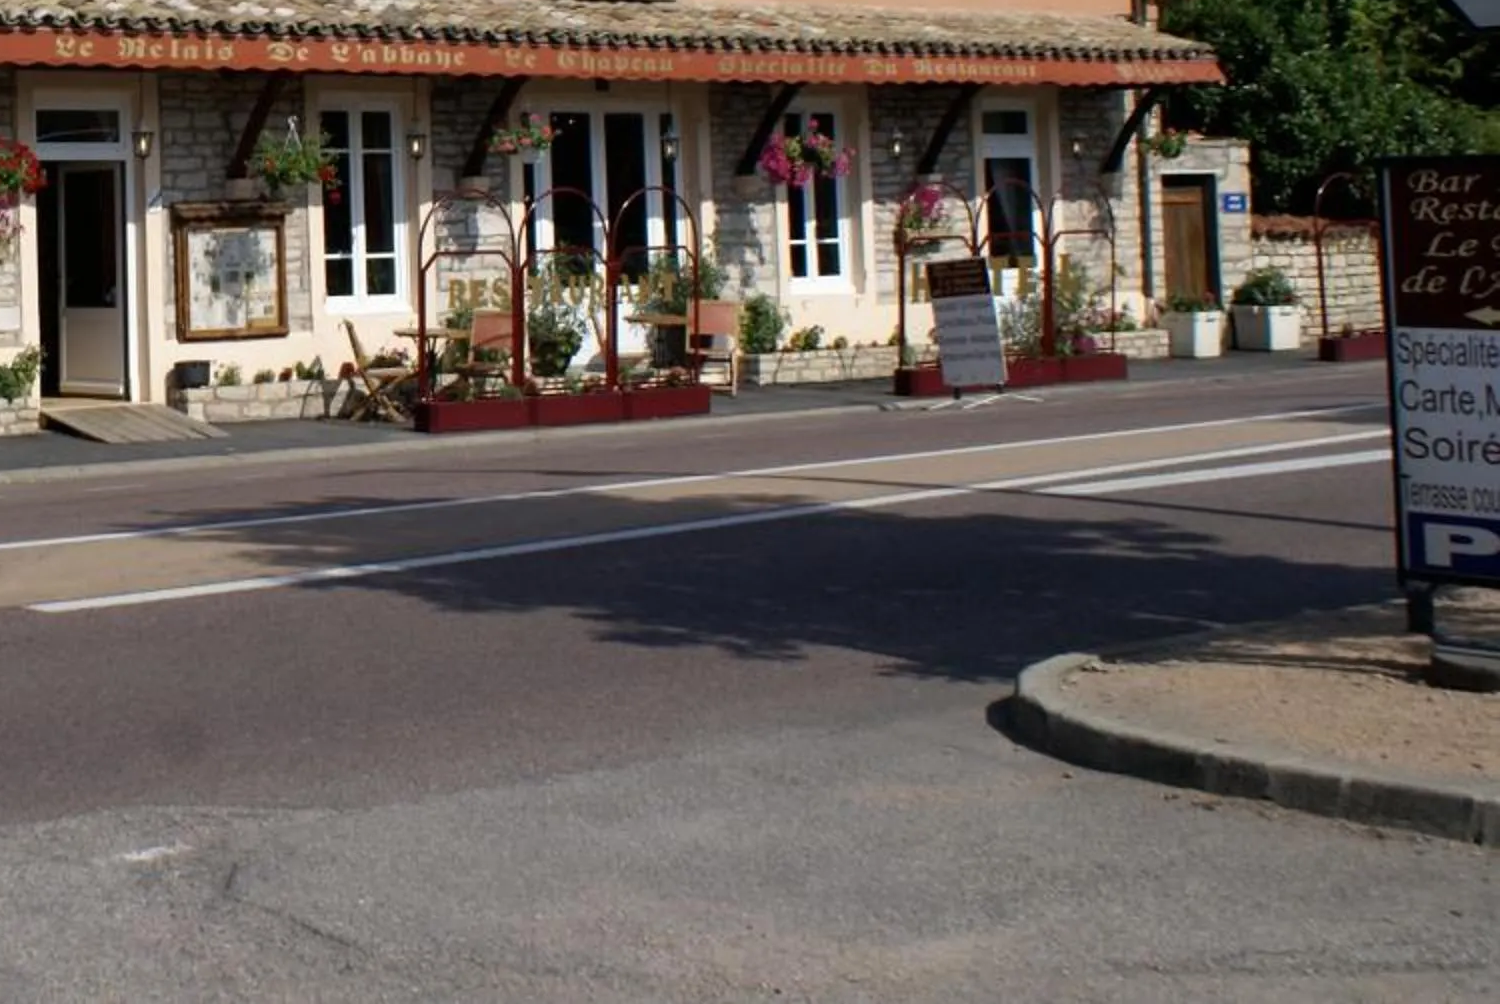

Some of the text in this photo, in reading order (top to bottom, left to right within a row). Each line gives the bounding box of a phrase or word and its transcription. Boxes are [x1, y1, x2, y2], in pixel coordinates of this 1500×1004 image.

[55, 35, 96, 58] Le
[117, 36, 234, 61] Relais
[266, 42, 310, 62] De
[1407, 168, 1482, 193] Bar
[1422, 231, 1479, 258] Le
[911, 253, 1076, 303] HTEL
[1401, 265, 1447, 294] de
